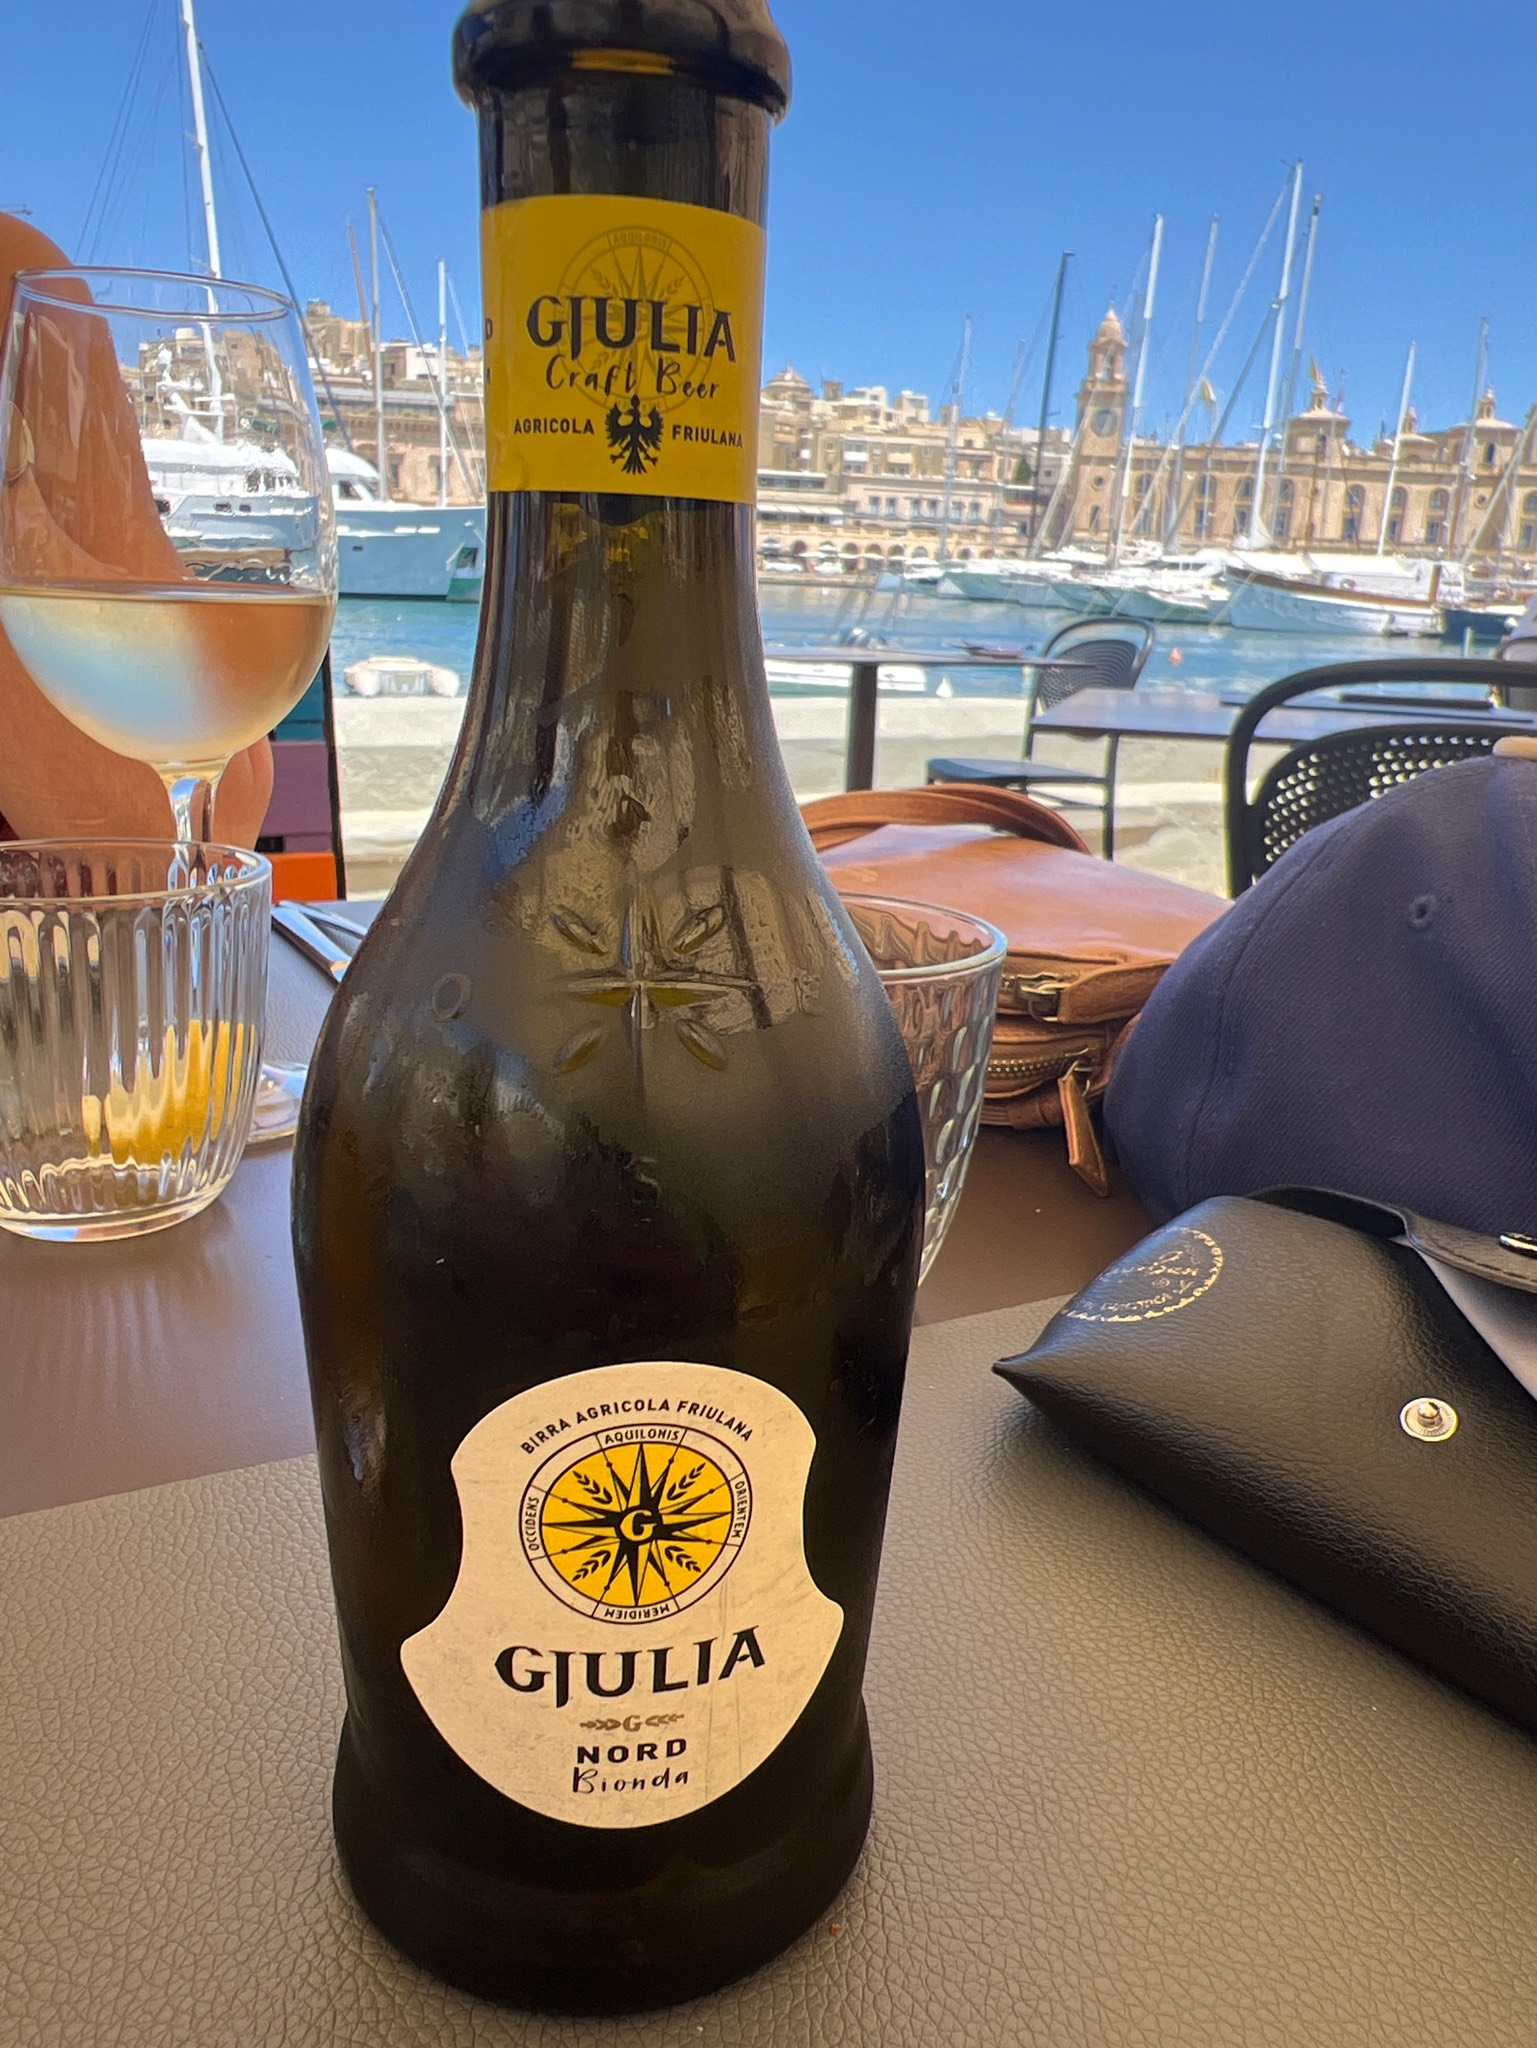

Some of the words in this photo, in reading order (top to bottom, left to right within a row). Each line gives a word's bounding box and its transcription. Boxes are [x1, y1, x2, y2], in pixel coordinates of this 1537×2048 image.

[545, 354, 637, 397] Craft
[656, 357, 720, 399] Beer
[513, 418, 595, 435] AGRICOLA
[672, 424, 743, 449] FRIULANA
[521, 1418, 572, 1454] BIRRA
[576, 1399, 670, 1425] AGRICOLA
[677, 1400, 753, 1442] FRIULANA
[604, 1428, 680, 1445] AQUILONIS
[527, 1496, 540, 1551] OCCIDENS
[734, 1480, 749, 1539] ORIENTEM
[620, 1510, 657, 1542] G
[604, 1603, 670, 1620] MERIDIEM
[623, 1715, 643, 1733] G
[577, 1738, 687, 1764] NORD
[573, 1767, 689, 1794] Bionda
